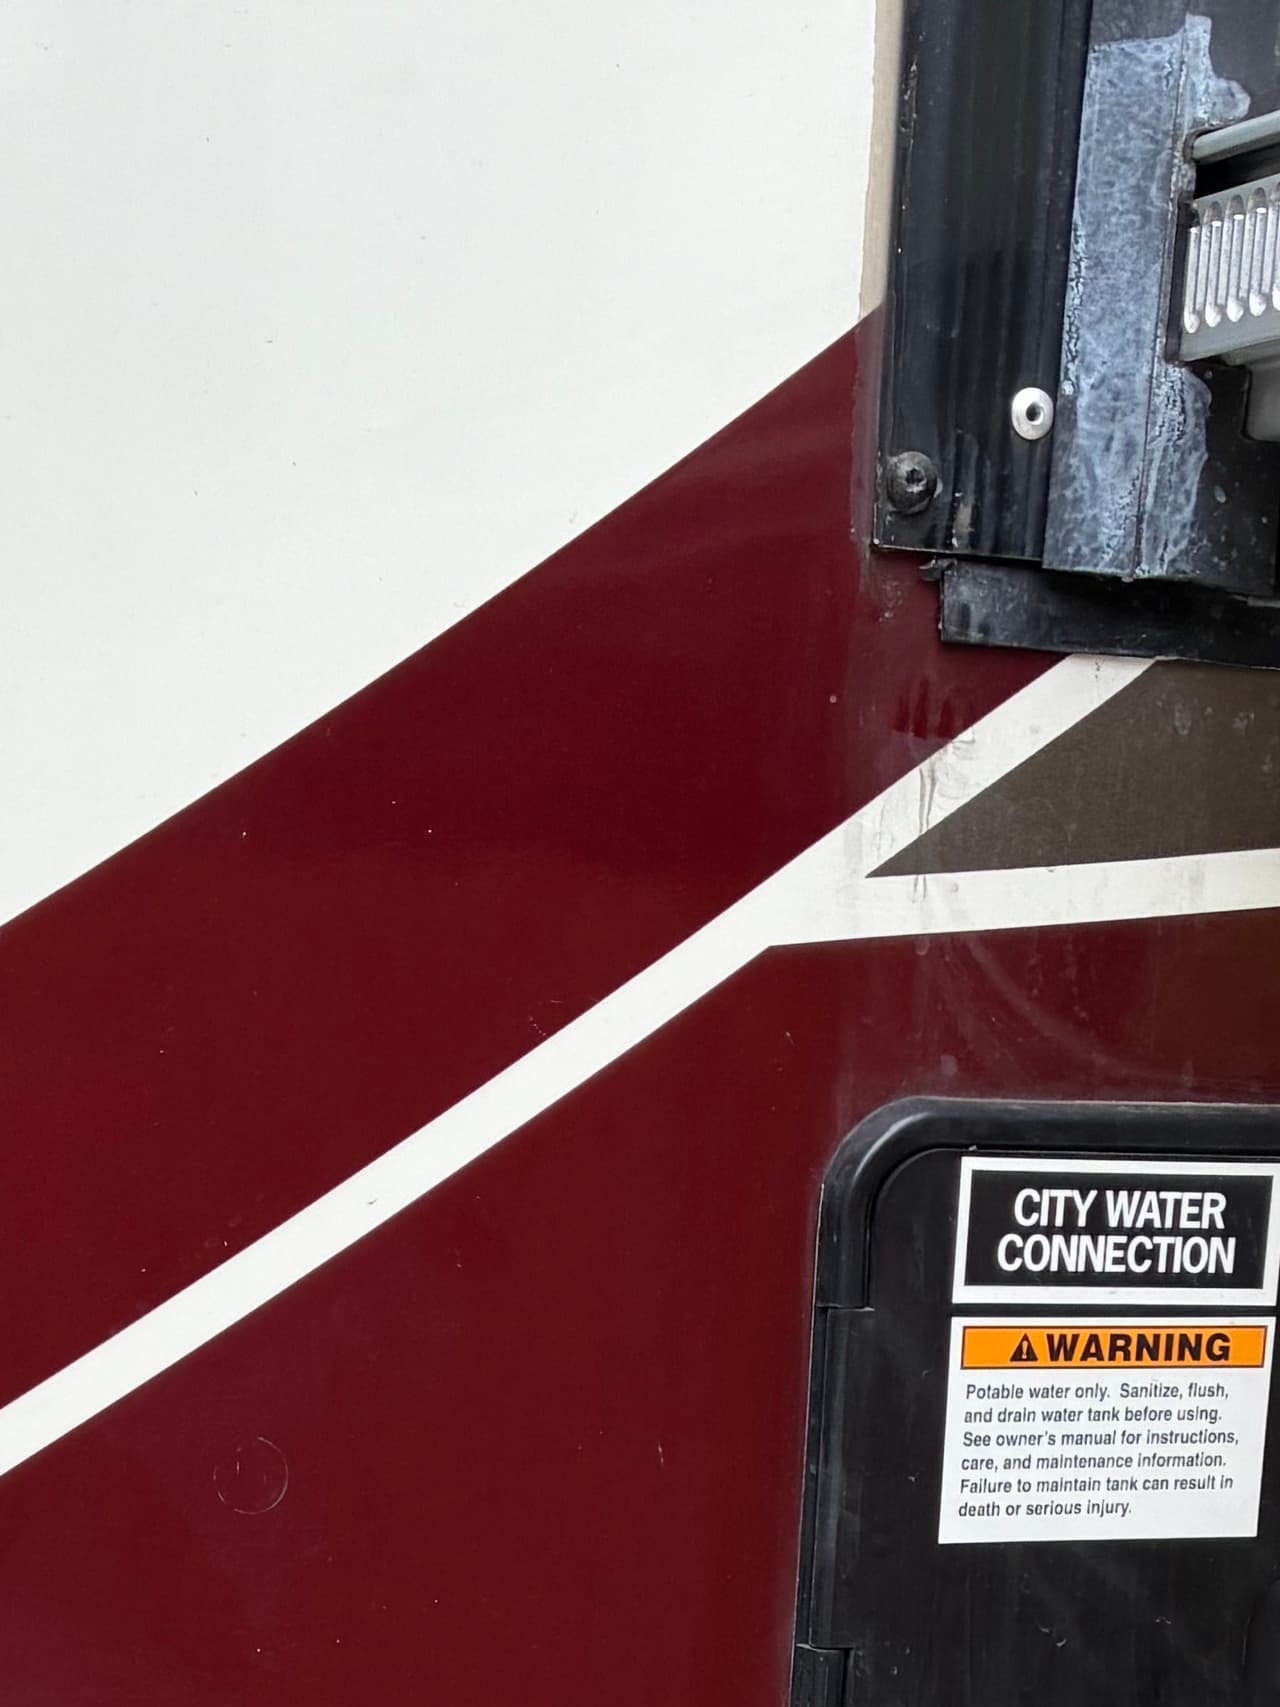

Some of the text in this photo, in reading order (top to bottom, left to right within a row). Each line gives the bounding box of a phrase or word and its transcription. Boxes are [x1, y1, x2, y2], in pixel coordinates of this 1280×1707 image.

[1014, 1189, 1227, 1230] CITY WATER
[997, 1234, 1236, 1274] CONNECTION
[1046, 1333, 1231, 1361] WARNING
[965, 1383, 1229, 1401] Potable water only. Sanitize, flush,
[964, 1407, 1222, 1424] and drain water tank before using.
[963, 1429, 1239, 1447] See owner's manual for instructions,
[961, 1453, 1227, 1472] care, and maintenance information.
[960, 1475, 1233, 1494] Failure to maintain tank can result in
[958, 1500, 1131, 1518] death or serious injury.
